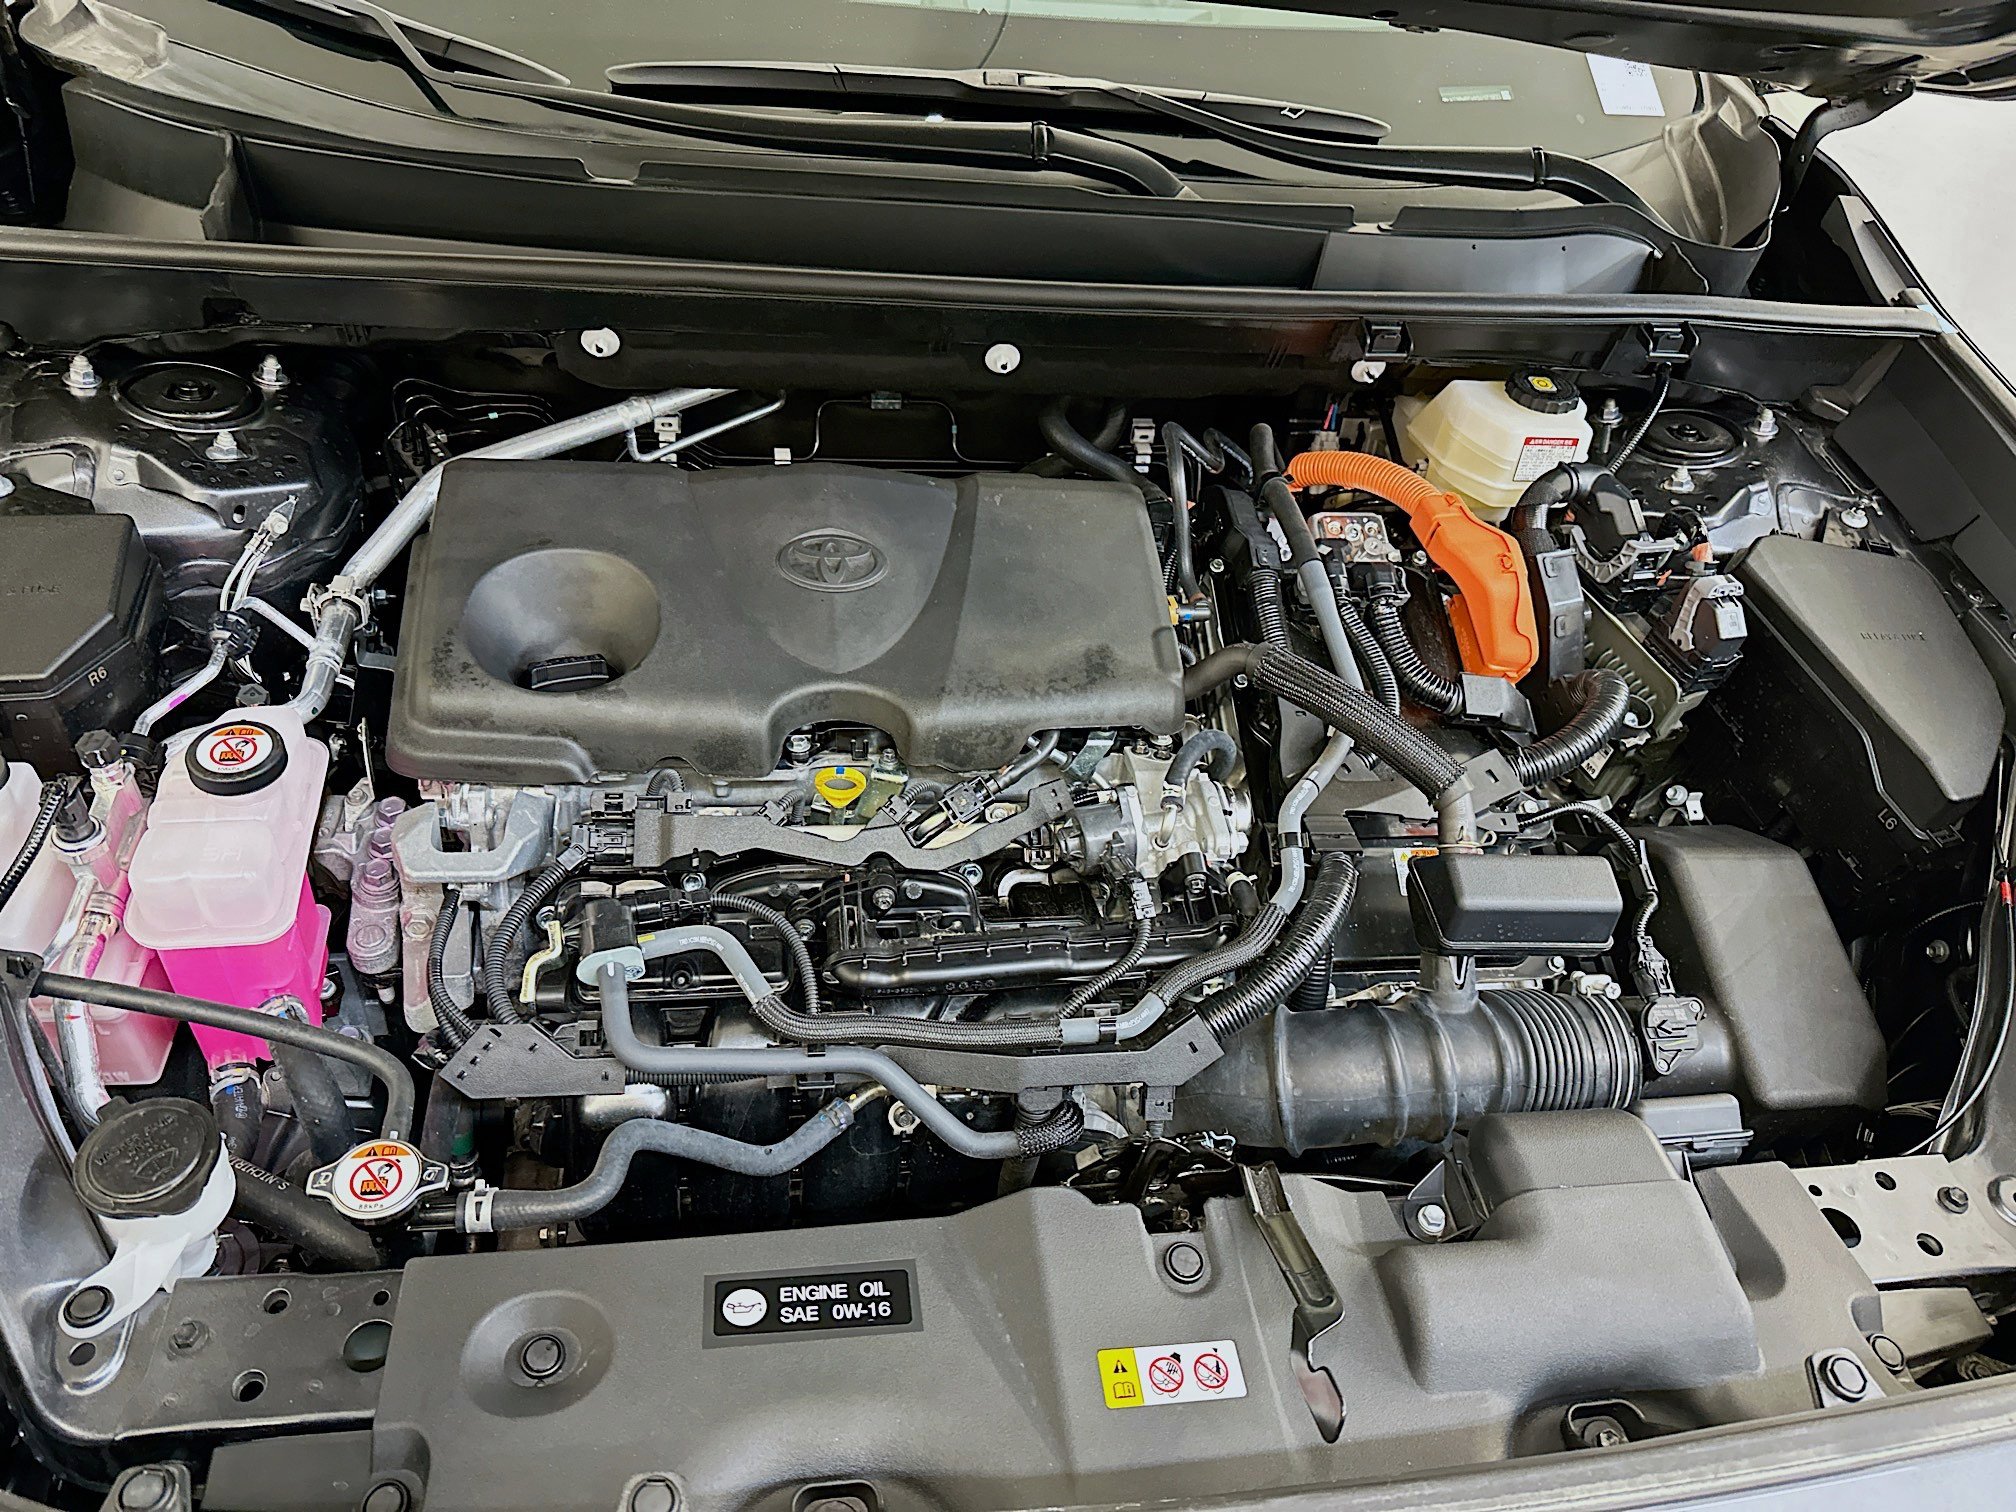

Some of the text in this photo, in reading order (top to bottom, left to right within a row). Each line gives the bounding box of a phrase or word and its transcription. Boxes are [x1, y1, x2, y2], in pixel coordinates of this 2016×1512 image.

[87, 666, 108, 687] R6
[1877, 808, 1898, 831] L6
[94, 1132, 141, 1167] WASHER
[779, 1281, 891, 1302] ENGINE OIL
[779, 1301, 892, 1324] SAE 0W-16
